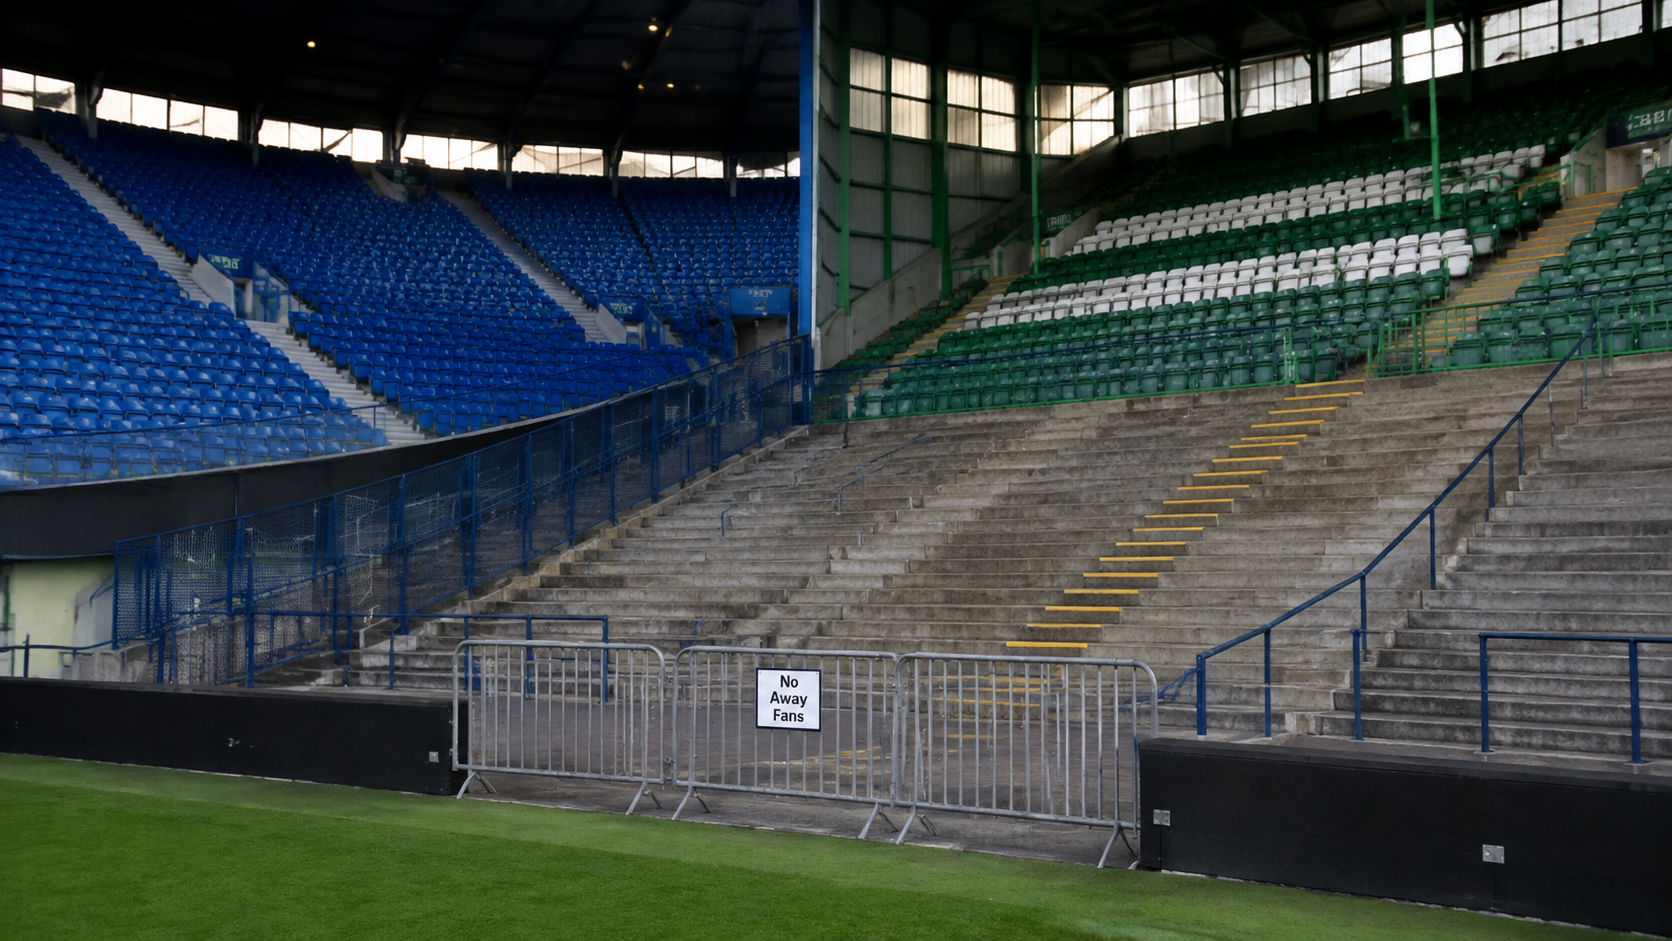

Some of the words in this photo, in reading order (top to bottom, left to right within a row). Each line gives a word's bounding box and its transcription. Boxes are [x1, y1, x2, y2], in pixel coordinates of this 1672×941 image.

[780, 675, 799, 688] No
[770, 691, 808, 708] Away
[773, 709, 804, 722] Fans
